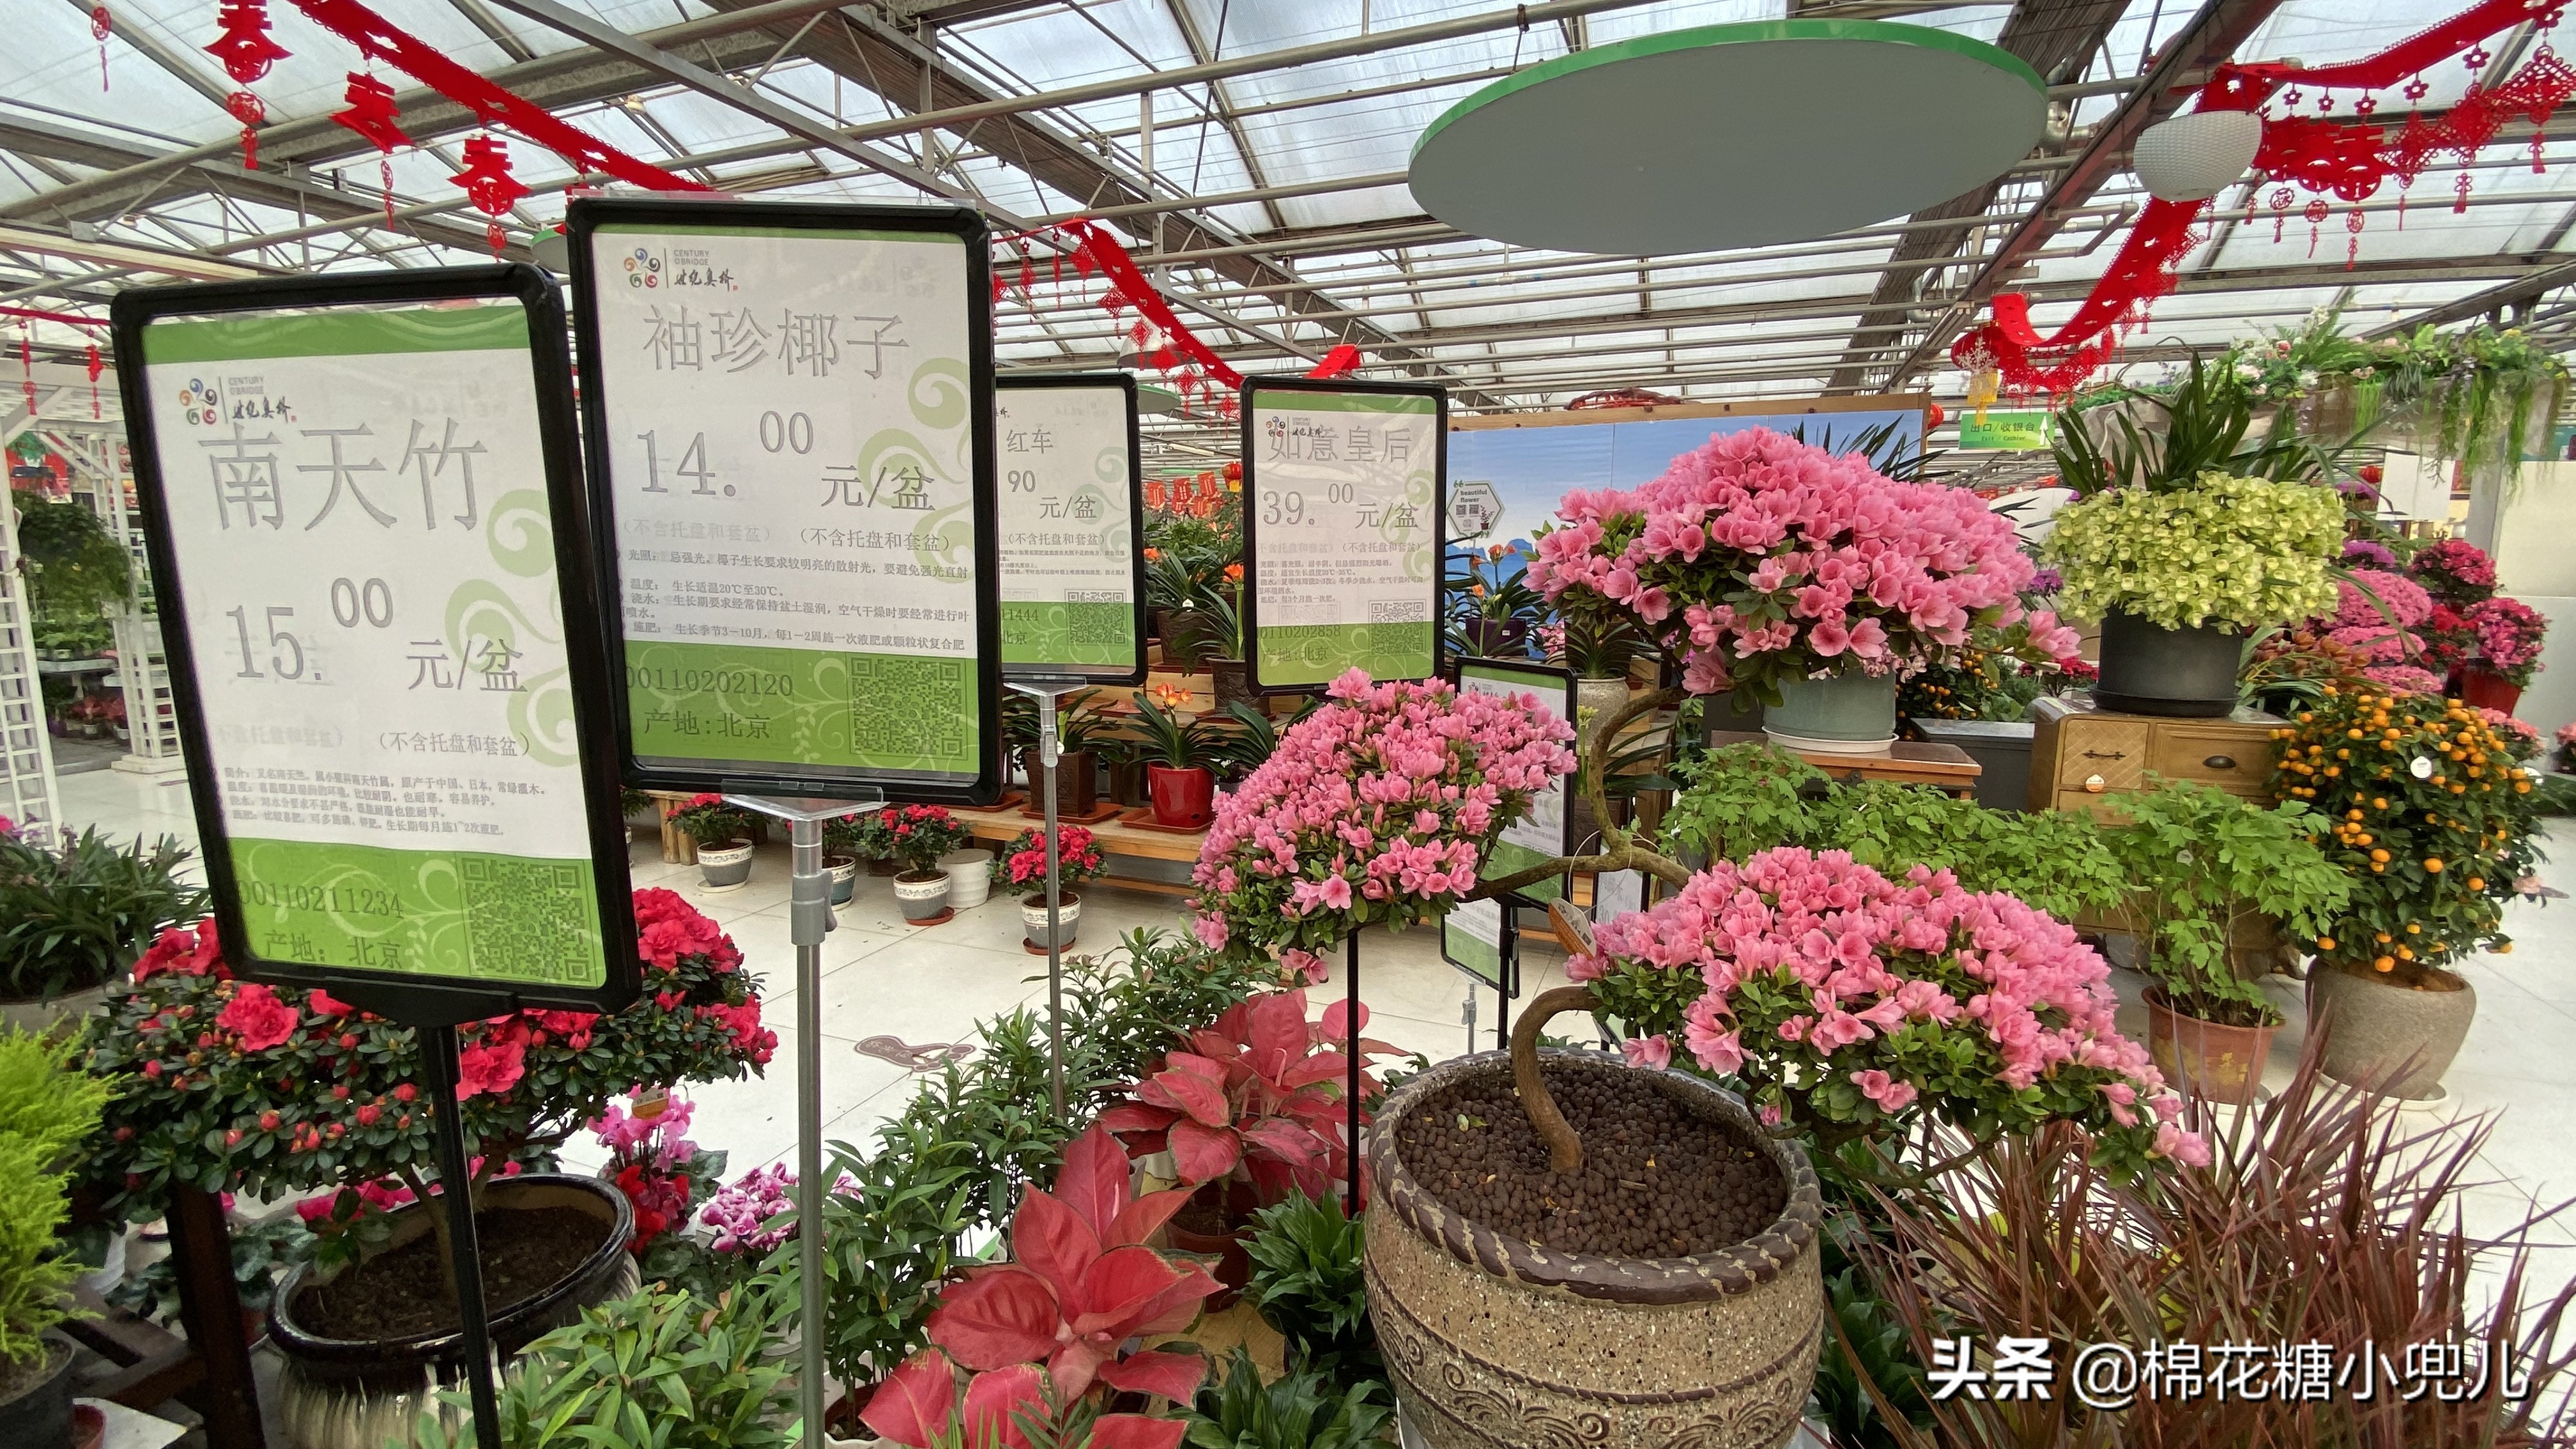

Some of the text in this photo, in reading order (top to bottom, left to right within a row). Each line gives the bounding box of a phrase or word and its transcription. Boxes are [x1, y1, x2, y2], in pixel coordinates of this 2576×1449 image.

[643, 303, 909, 379] 袖珍椰子
[229, 376, 264, 385] CENTURY
[1970, 422, 2035, 433] 出口/收银台
[1007, 429, 1054, 454] 红车
[1269, 425, 1412, 463] 如意皇后
[637, 411, 935, 511] 14. 00 元/盆
[199, 417, 487, 532] 南天竹
[1008, 470, 1097, 519] 90 元/盆
[1263, 483, 1419, 528] 39. 00 元/盆
[799, 527, 951, 553] （不含托盘和套盆）
[1009, 533, 1105, 546] （不含托盘和套盆）
[1342, 542, 1421, 553] （不含托盘和套盆）
[226, 577, 526, 692] 15. 00 元/盆
[1002, 631, 1027, 645] 北京
[1262, 646, 1328, 662] 产地:北京
[645, 709, 770, 739] 产地:北京
[379, 732, 531, 758] （不含托盘和套盆）
